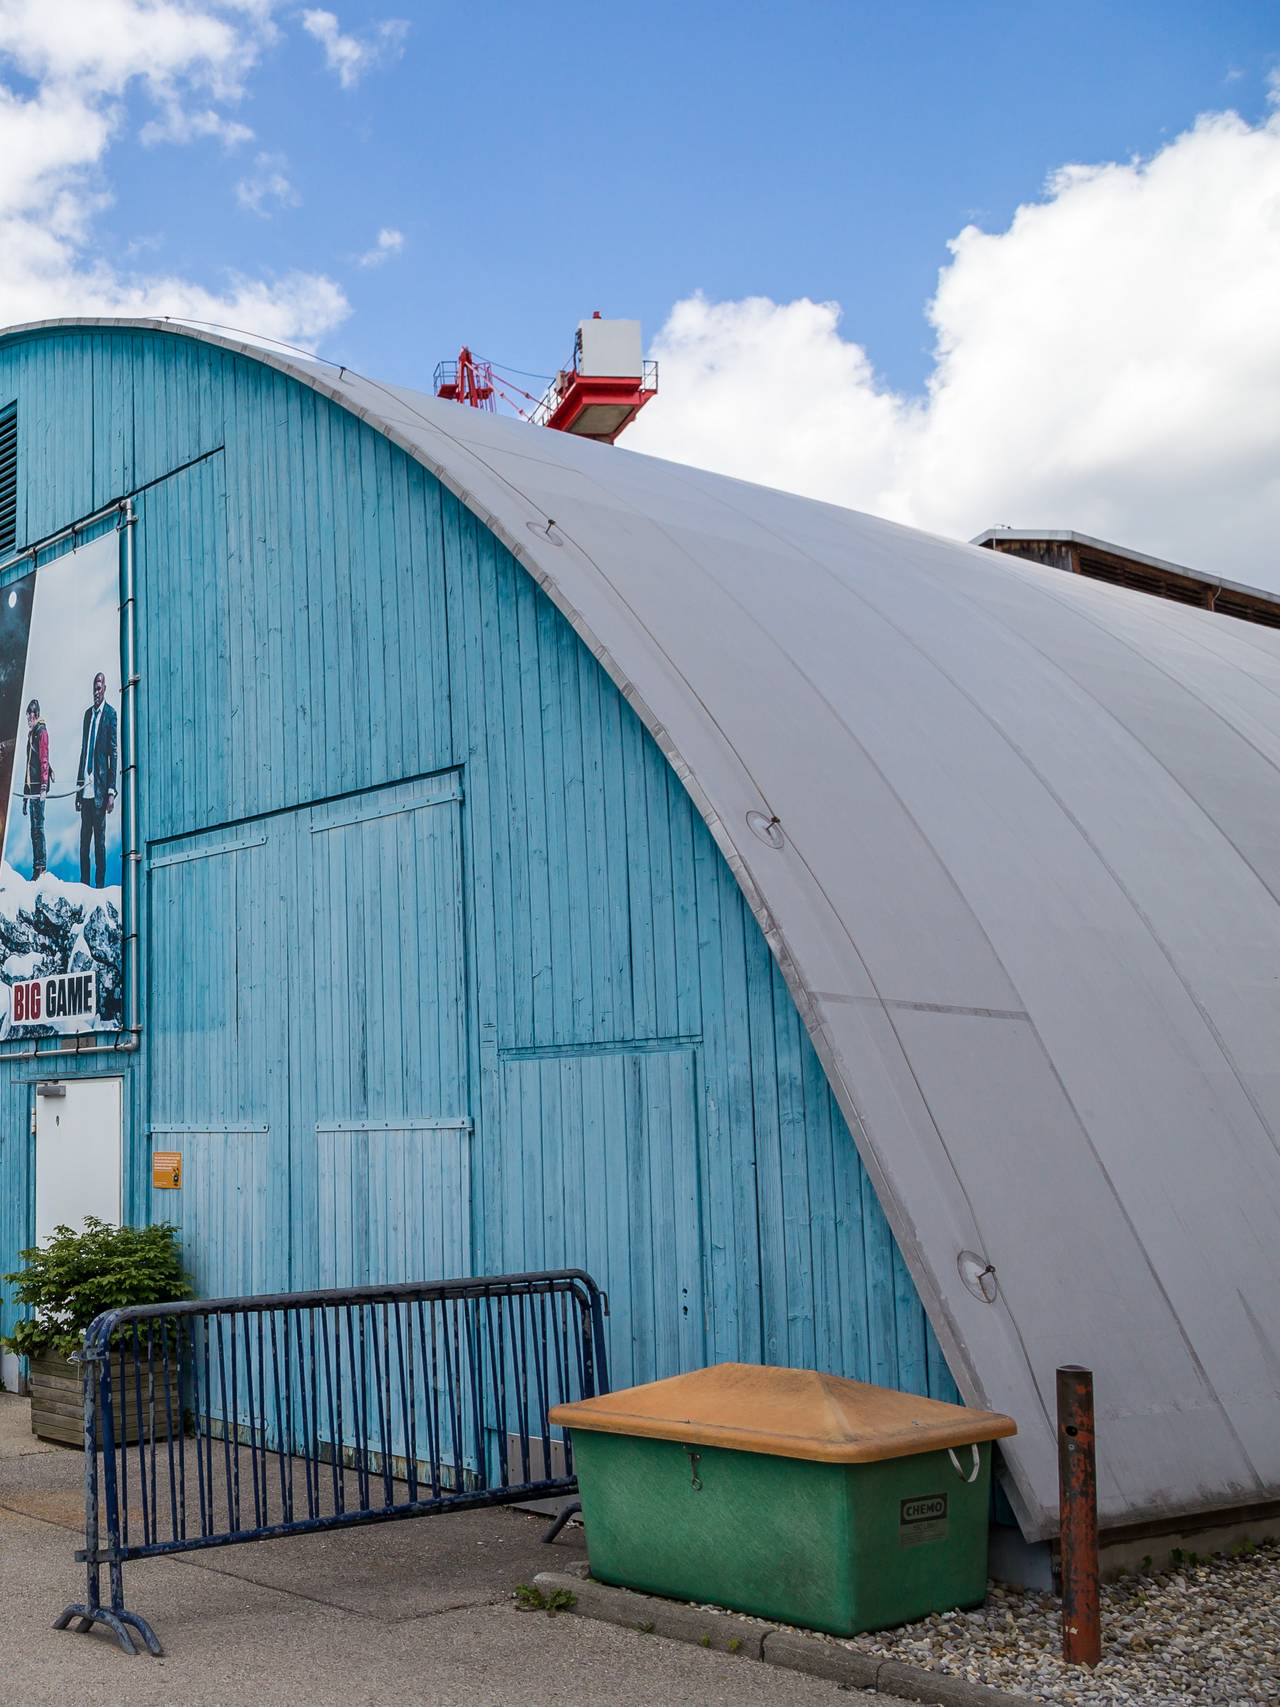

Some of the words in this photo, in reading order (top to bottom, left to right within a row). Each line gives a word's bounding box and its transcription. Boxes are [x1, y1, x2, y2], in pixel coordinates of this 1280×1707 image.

[14, 982, 41, 1021] BIG
[46, 975, 93, 1018] GAME
[906, 1502, 943, 1517] CHEMO
